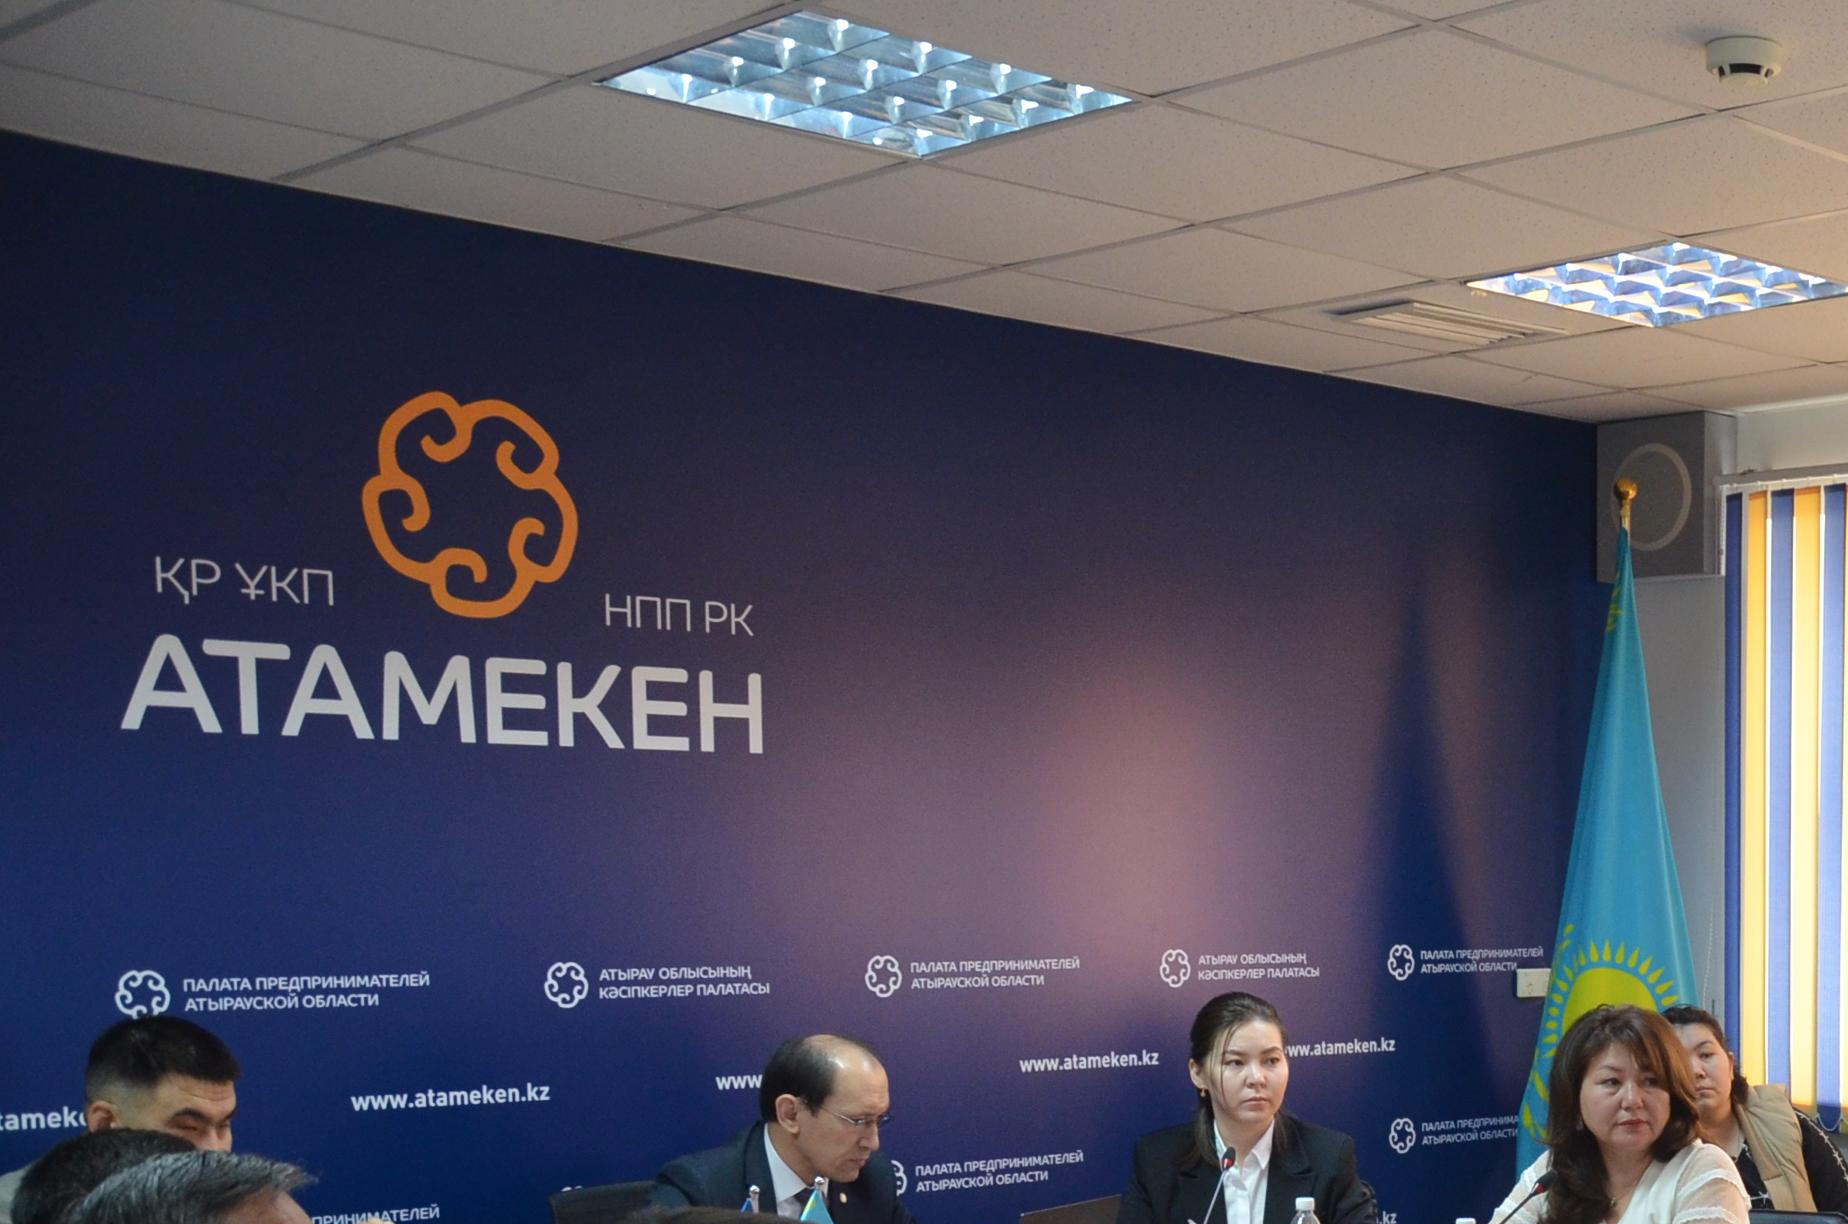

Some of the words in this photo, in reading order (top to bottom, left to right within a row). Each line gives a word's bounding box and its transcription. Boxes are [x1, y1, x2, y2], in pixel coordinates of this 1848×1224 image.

[155, 555, 222, 605] ҚР
[234, 562, 335, 607] ҰКП
[604, 593, 692, 632] НПП
[704, 600, 755, 637] РК
[120, 633, 763, 754] АТАМЕКЕН
[1198, 954, 1238, 966] АТЫРАУ
[1420, 950, 1455, 960] ПАЛАТА
[1455, 945, 1544, 960] ПРЕДПРИНИМАТЕЛЕЙ
[599, 967, 655, 982] АТЫРАУ
[658, 965, 752, 980] ОБЛЫСЫНЫҢ
[910, 960, 957, 974] ПАЛАТА
[959, 955, 1081, 974] ПРЕДПРИНИМАТЕЛЕЙ
[1198, 968, 1266, 981] КӘСІПКЕРЛЕР
[1267, 966, 1320, 979] ПАЛАТАСЫ
[1420, 961, 1478, 974] АТЫРАУСКОЙ
[1478, 962, 1518, 972] ОБЛАСТИ
[183, 976, 253, 993] ПАЛАТА
[255, 970, 430, 994] ПРЕДПРИНИМАТЕЛЕЙ
[599, 985, 694, 1000] КӘСІПКЕРЛЕР
[696, 982, 770, 997] ПАЛАТАСЫ
[911, 974, 990, 990] АТЫРАУСКОЙ
[991, 974, 1045, 988] ОБЛАСТИ
[184, 992, 300, 1013] АТЫРАУСКОЙ
[301, 993, 380, 1009] ОБЛАСТИ
[1285, 1036, 1396, 1057] ww.atameken.kz
[1019, 1049, 1160, 1073] www.atameken.kz
[350, 1082, 551, 1112] www.atameken.kz
[1421, 1120, 1456, 1132] ПАЛАТА
[1456, 1115, 1519, 1129] ПРЕДПРИНИМА
[1422, 1129, 1479, 1145] АТЫРАУСКОЙ
[915, 1162, 962, 1177] ПАЛАТА
[963, 1149, 1084, 1173] ПРЕДПРИНИМАТЕЛЕЙ
[915, 1173, 994, 1193] АТЫРАУСКОЙ
[995, 1170, 1049, 1187] ОБЛАСТИ
